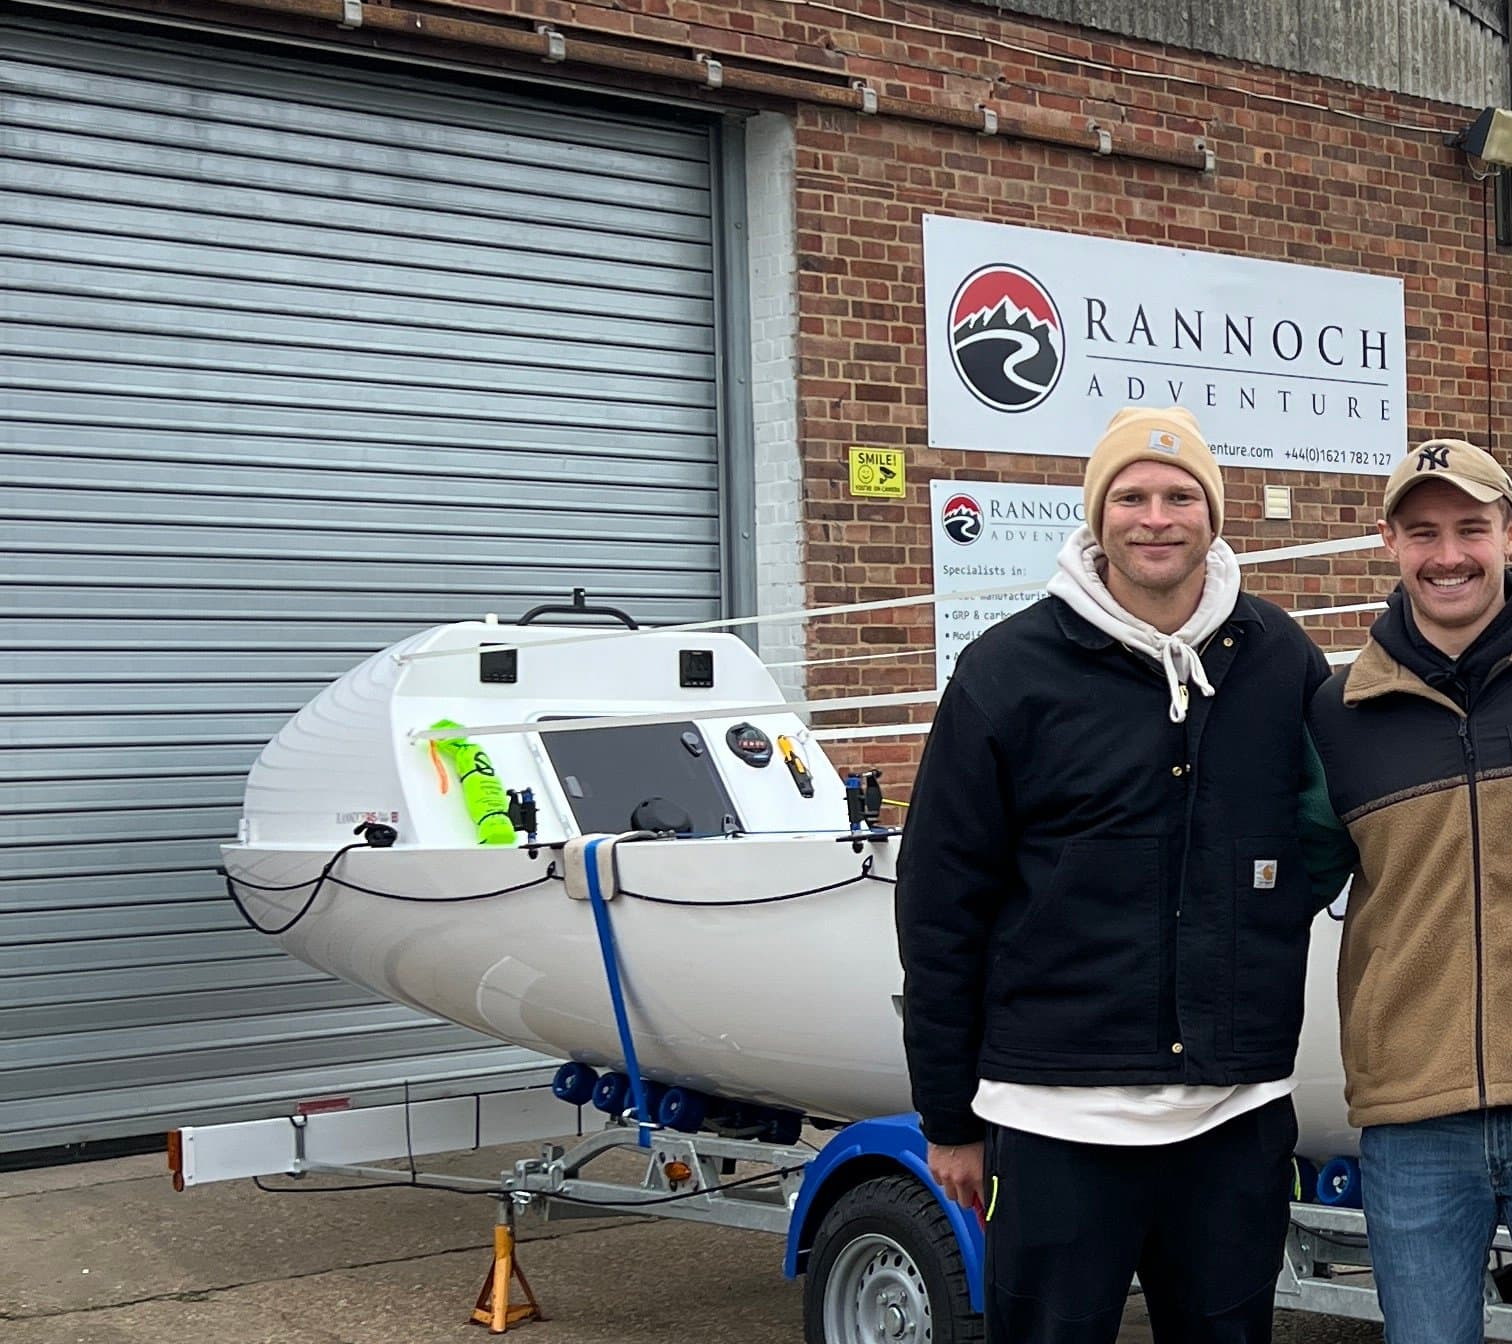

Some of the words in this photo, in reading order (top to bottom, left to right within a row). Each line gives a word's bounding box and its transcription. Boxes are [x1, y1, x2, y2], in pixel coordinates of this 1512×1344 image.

[1084, 297, 1390, 370] RANNOCH
[1086, 373, 1391, 421] ADVENTURE
[858, 452, 896, 466] SMILE!
[1208, 442, 1273, 458] enture.com
[1285, 447, 1346, 464] +44(0)1621
[1350, 451, 1369, 465] 782
[1373, 453, 1391, 465] 127
[1416, 444, 1449, 471] NY
[991, 499, 1085, 521] RANNOC
[991, 529, 1065, 543] ADVENT
[943, 564, 1006, 577] Specialists
[1011, 565, 1027, 576] in:
[952, 610, 970, 620] GRP
[973, 610, 980, 620] &
